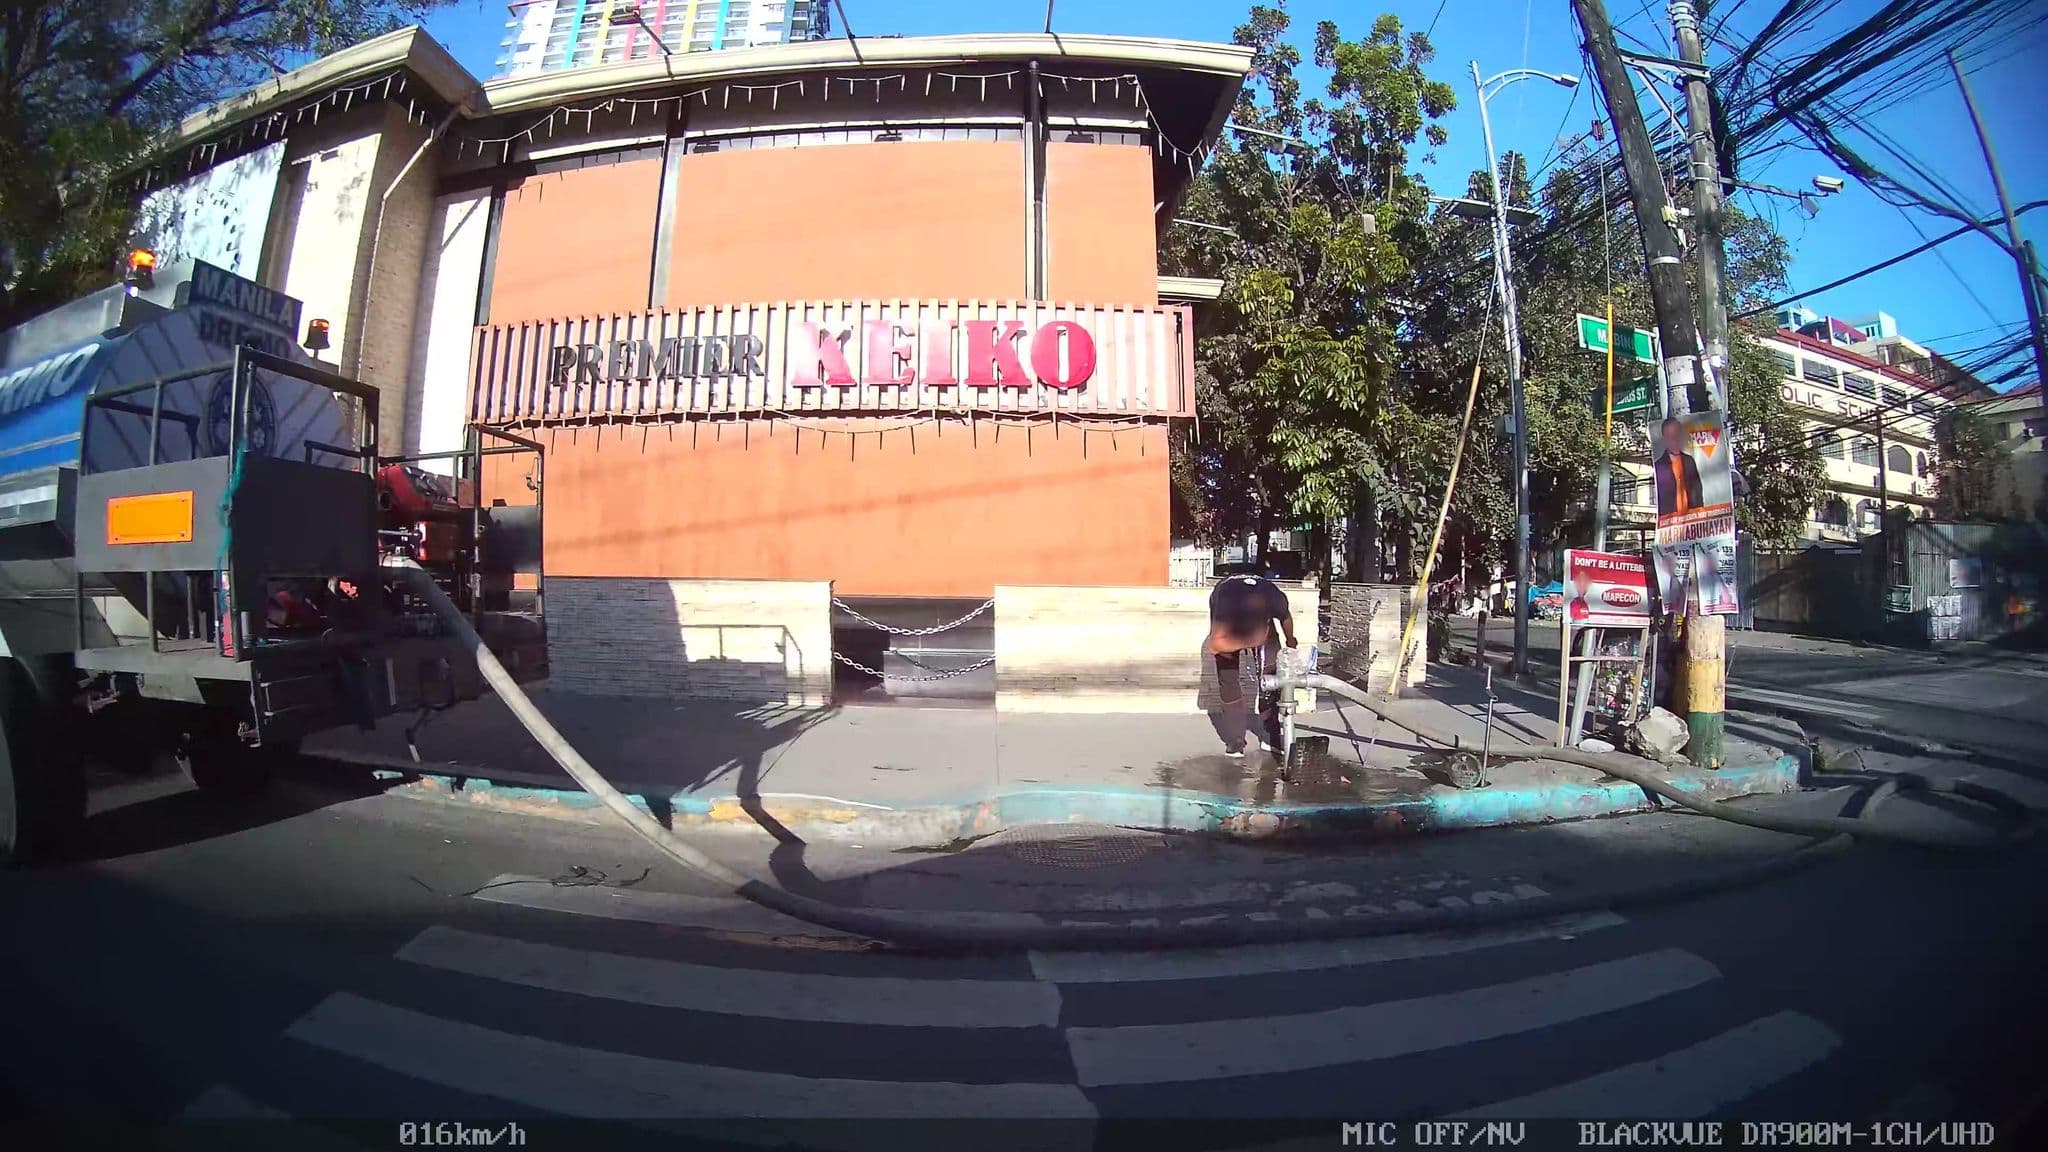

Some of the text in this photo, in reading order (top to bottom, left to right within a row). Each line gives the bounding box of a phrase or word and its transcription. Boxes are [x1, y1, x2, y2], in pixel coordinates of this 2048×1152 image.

[197, 266, 294, 328] MANILA
[1597, 327, 1634, 350] MBINI
[551, 319, 1097, 390] PREMIER KEIKO
[1781, 384, 1823, 409] OLIC
[1574, 557, 1597, 567] DON'T
[1598, 559, 1608, 569] BE
[1609, 561, 1615, 570] A
[1602, 592, 1640, 604] MAPECON
